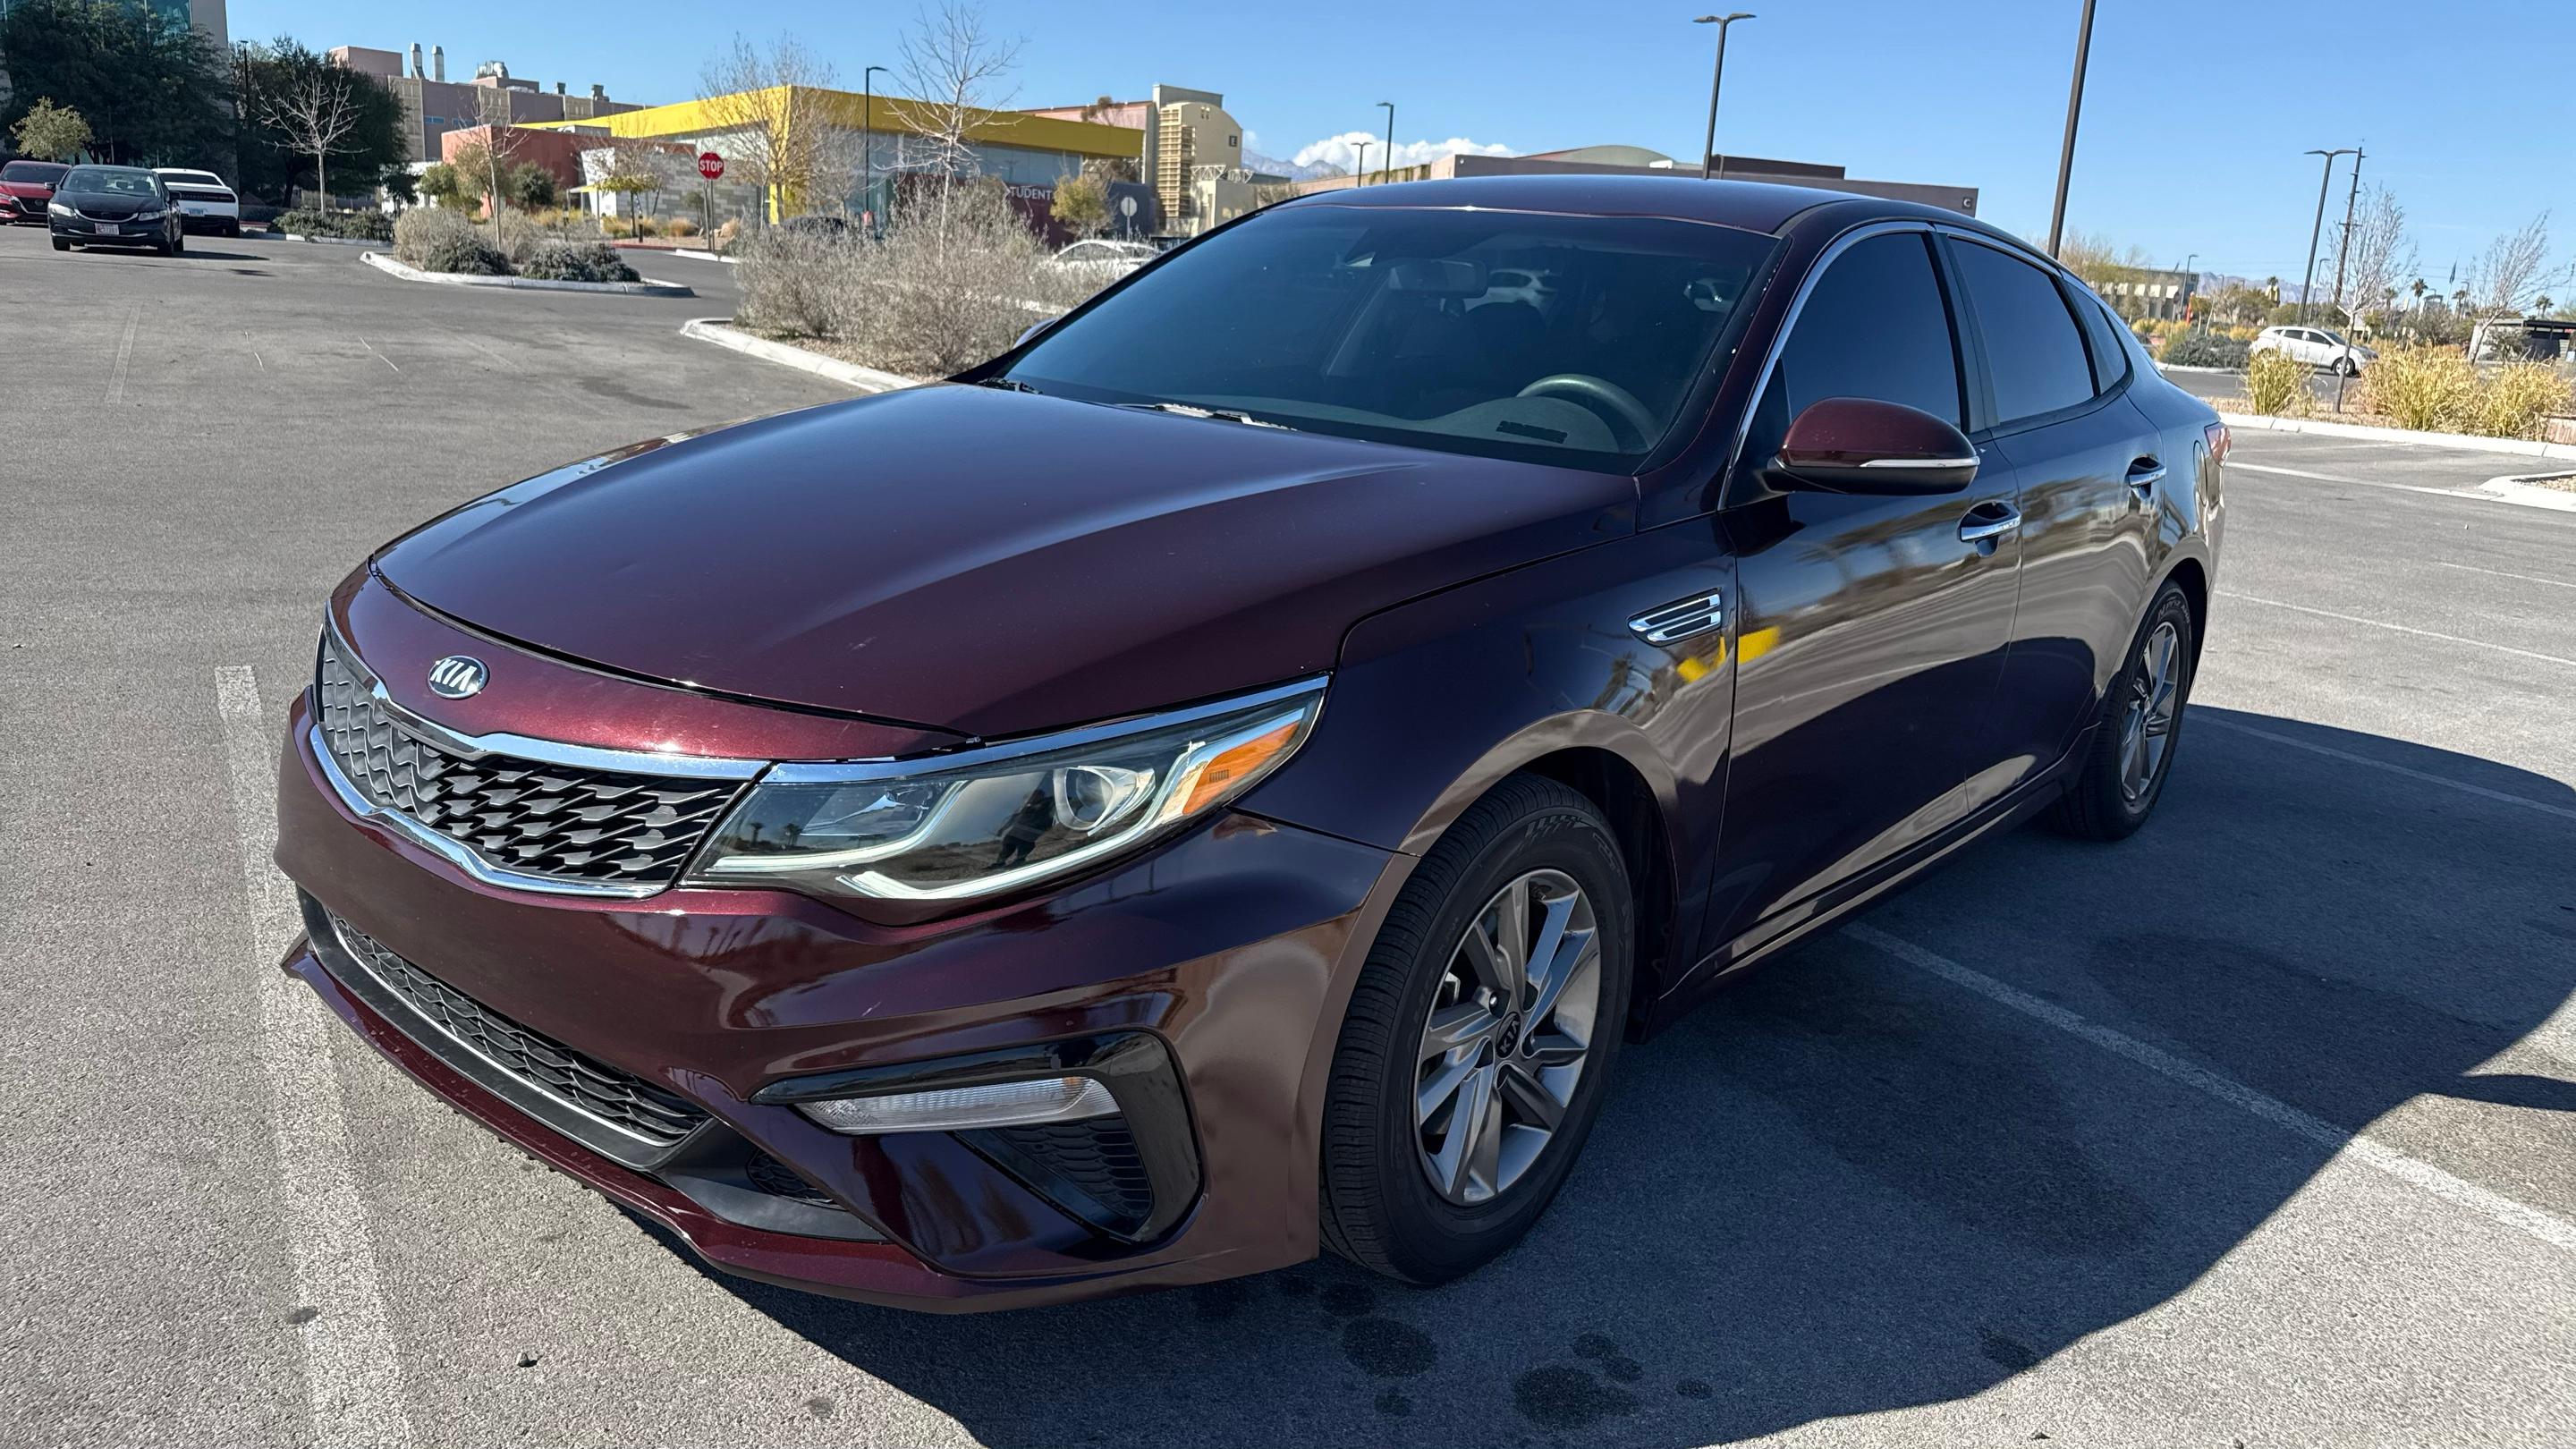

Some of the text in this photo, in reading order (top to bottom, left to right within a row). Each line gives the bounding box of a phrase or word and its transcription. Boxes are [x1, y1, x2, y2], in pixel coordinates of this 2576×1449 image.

[699, 159, 724, 172] STOP
[1004, 185, 1053, 200] TUDENT
[1963, 198, 1971, 208] C
[429, 657, 478, 691] KIA
[1499, 1020, 1520, 1054] KIA
